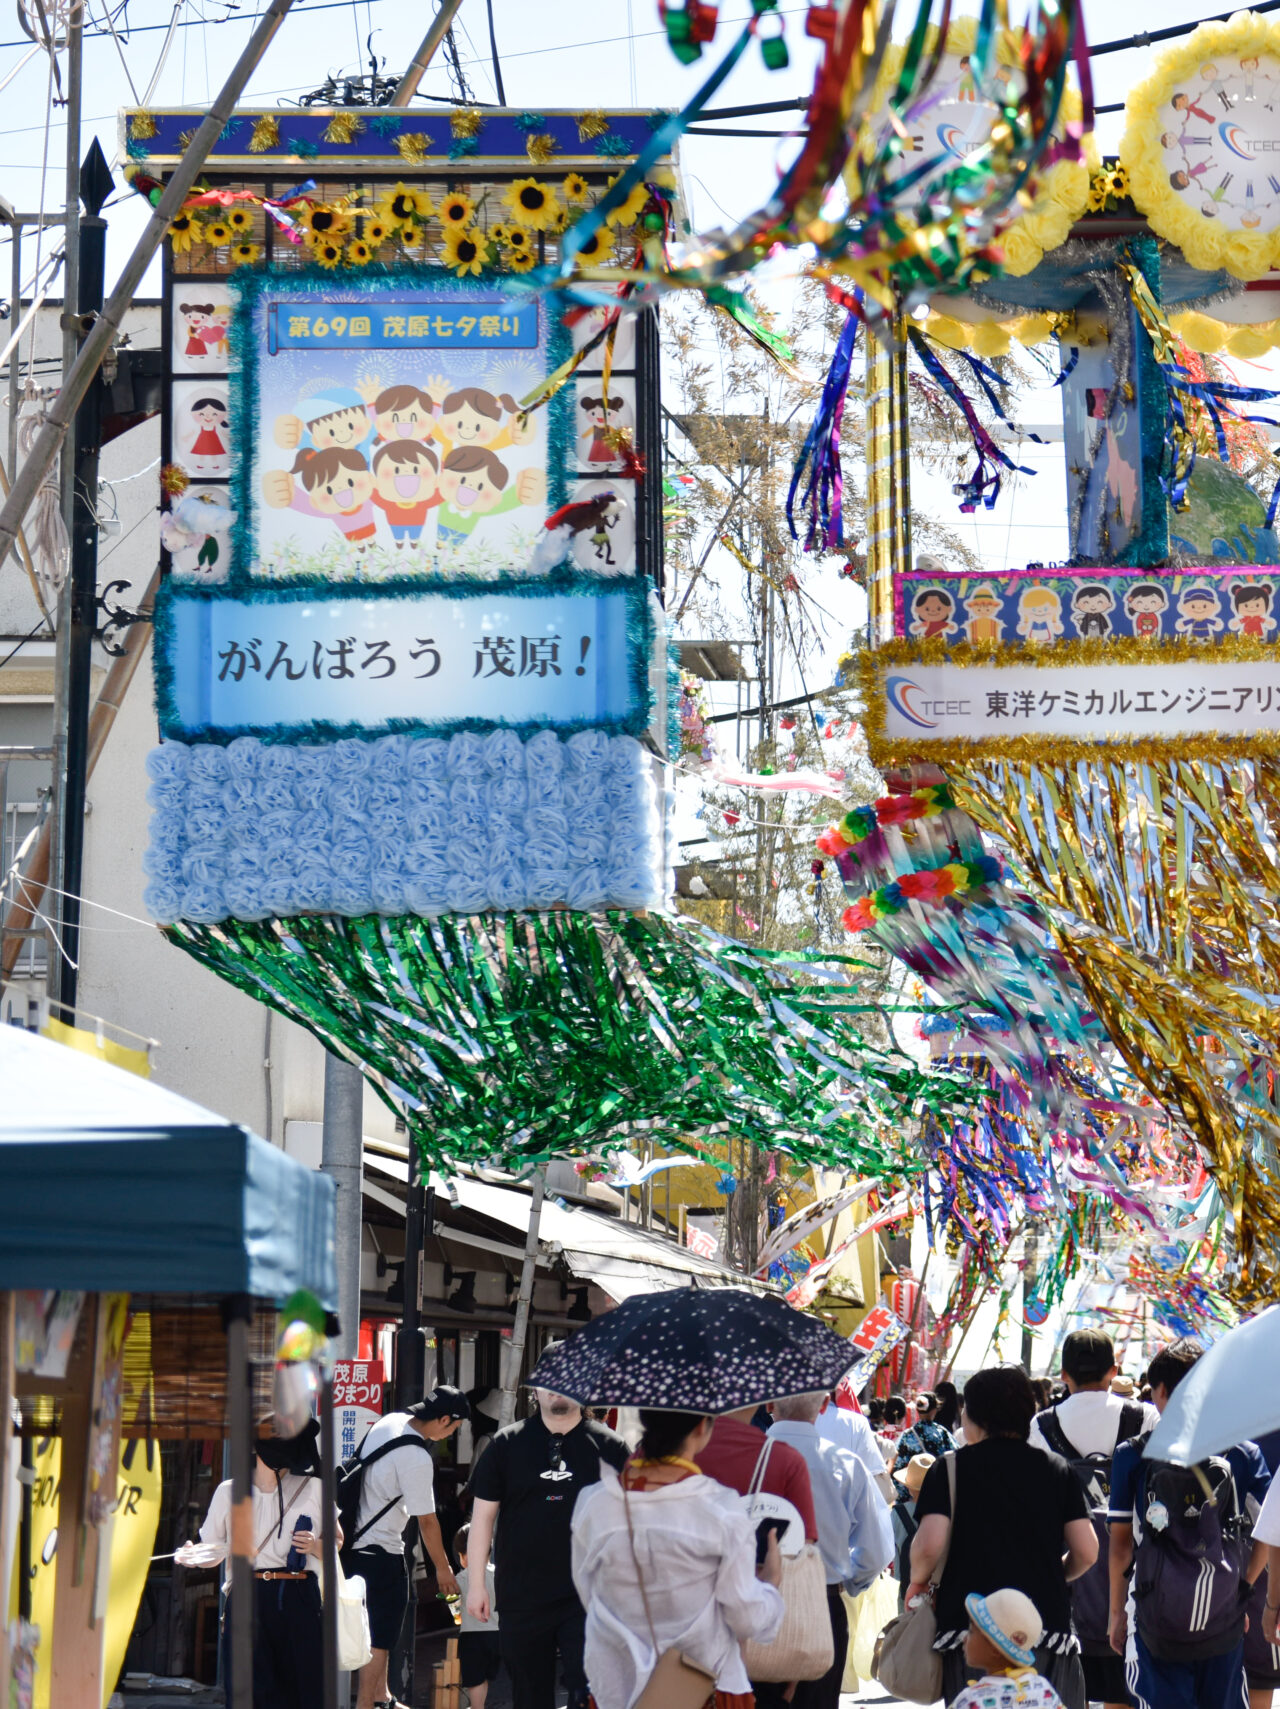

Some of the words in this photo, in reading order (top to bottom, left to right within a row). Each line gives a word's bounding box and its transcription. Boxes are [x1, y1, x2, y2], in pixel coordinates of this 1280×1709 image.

[1244, 140, 1280, 152] TCEC
[288, 316, 372, 338] 第69回
[382, 315, 520, 338] 茂原七夕祭り
[216, 636, 442, 682] がんばろう
[471, 634, 593, 679] 茂原！
[920, 700, 972, 716] TCEC
[333, 1363, 369, 1384] 茂原
[333, 1383, 381, 1404] 夕まつり
[341, 1410, 356, 1465] 開催期
